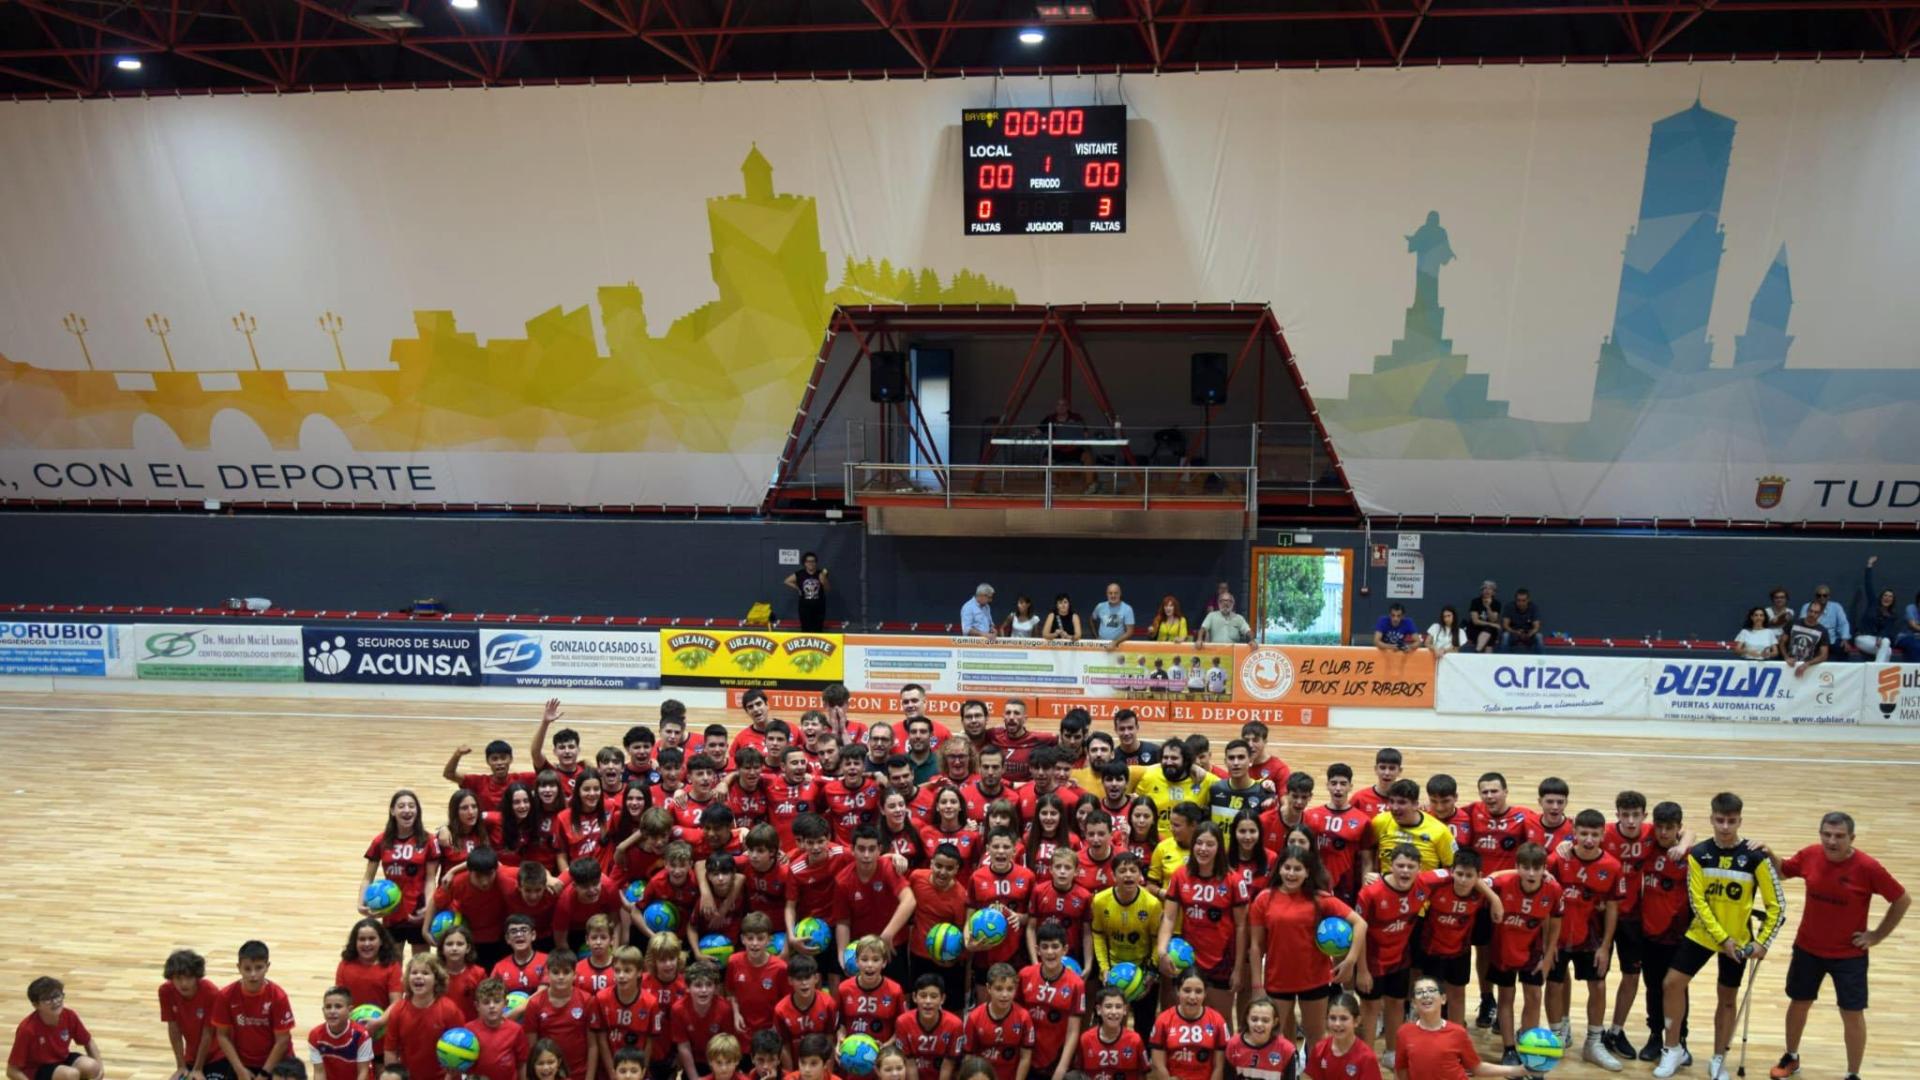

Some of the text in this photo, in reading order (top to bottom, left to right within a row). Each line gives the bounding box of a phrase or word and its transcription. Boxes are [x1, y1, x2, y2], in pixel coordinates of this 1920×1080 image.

[1004, 110, 1084, 136] 00:00
[970, 145, 1013, 157] LOCAL
[1075, 143, 1118, 155] VISITANTE
[1044, 156, 1051, 173] 1
[980, 164, 1014, 190] 00
[1085, 162, 1120, 187] 00
[1030, 178, 1061, 189] PERIODO
[979, 200, 991, 219] 0
[1099, 198, 1111, 217] 3
[972, 223, 1001, 232] FALTAS
[1026, 222, 1063, 231] JUGADOR
[1090, 221, 1121, 231] FALTAS
[33, 463, 134, 487] CON
[148, 464, 205, 488] EL
[217, 464, 436, 491] DEPORTE
[357, 637, 470, 650] SEGUROS DE SALUD
[550, 640, 657, 654] GONZALO CASADO S.L.
[671, 635, 715, 648] URZANTE
[729, 637, 773, 651] URZANTE
[786, 638, 831, 652] URZANTE
[357, 653, 472, 676] ACUNSA
[1300, 658, 1375, 676] EL CLUB DE
[517, 677, 624, 688] www.gruasgonzalo.com
[720, 678, 777, 687] www.urzante.com
[1211, 672, 1222, 681] 24
[1494, 662, 1590, 690] ariza
[1653, 664, 1782, 698] DUBLAN
[1299, 679, 1340, 696] TODOS
[1342, 680, 1367, 696] LOS
[1371, 681, 1426, 697] RIBEROS
[1777, 689, 1794, 699] S.L.
[848, 697, 880, 710] CON
[1671, 701, 1775, 711] PUERTAS AUTOMÁTICAS
[1130, 704, 1166, 719] CON
[1175, 706, 1195, 719] EL
[1202, 707, 1283, 722] DEPORTE
[1006, 748, 1014, 759] 7
[742, 797, 759, 812] 34
[844, 792, 866, 809] 46
[581, 820, 600, 834] 32
[1324, 815, 1342, 832] 10
[1544, 833, 1554, 847] 7
[392, 844, 413, 860] 30
[1039, 844, 1056, 858] 13
[1619, 842, 1641, 858] 20
[1654, 856, 1666, 872] 6
[1096, 868, 1107, 884] 4
[1243, 869, 1252, 885] 9
[1576, 867, 1588, 883] 4
[993, 880, 1010, 895] 10
[1192, 884, 1215, 902] 20
[1056, 898, 1064, 911] 5
[1399, 897, 1410, 913] 3
[1452, 900, 1467, 913] 15
[1521, 899, 1533, 914] 5
[591, 974, 607, 990] 16
[1036, 985, 1057, 1003] 37
[857, 996, 877, 1013] 25
[617, 1009, 632, 1025] 18
[994, 1026, 1003, 1042] 2
[1178, 1025, 1203, 1043] 28
[918, 1035, 938, 1051] 27
[1098, 1050, 1119, 1066] 23
